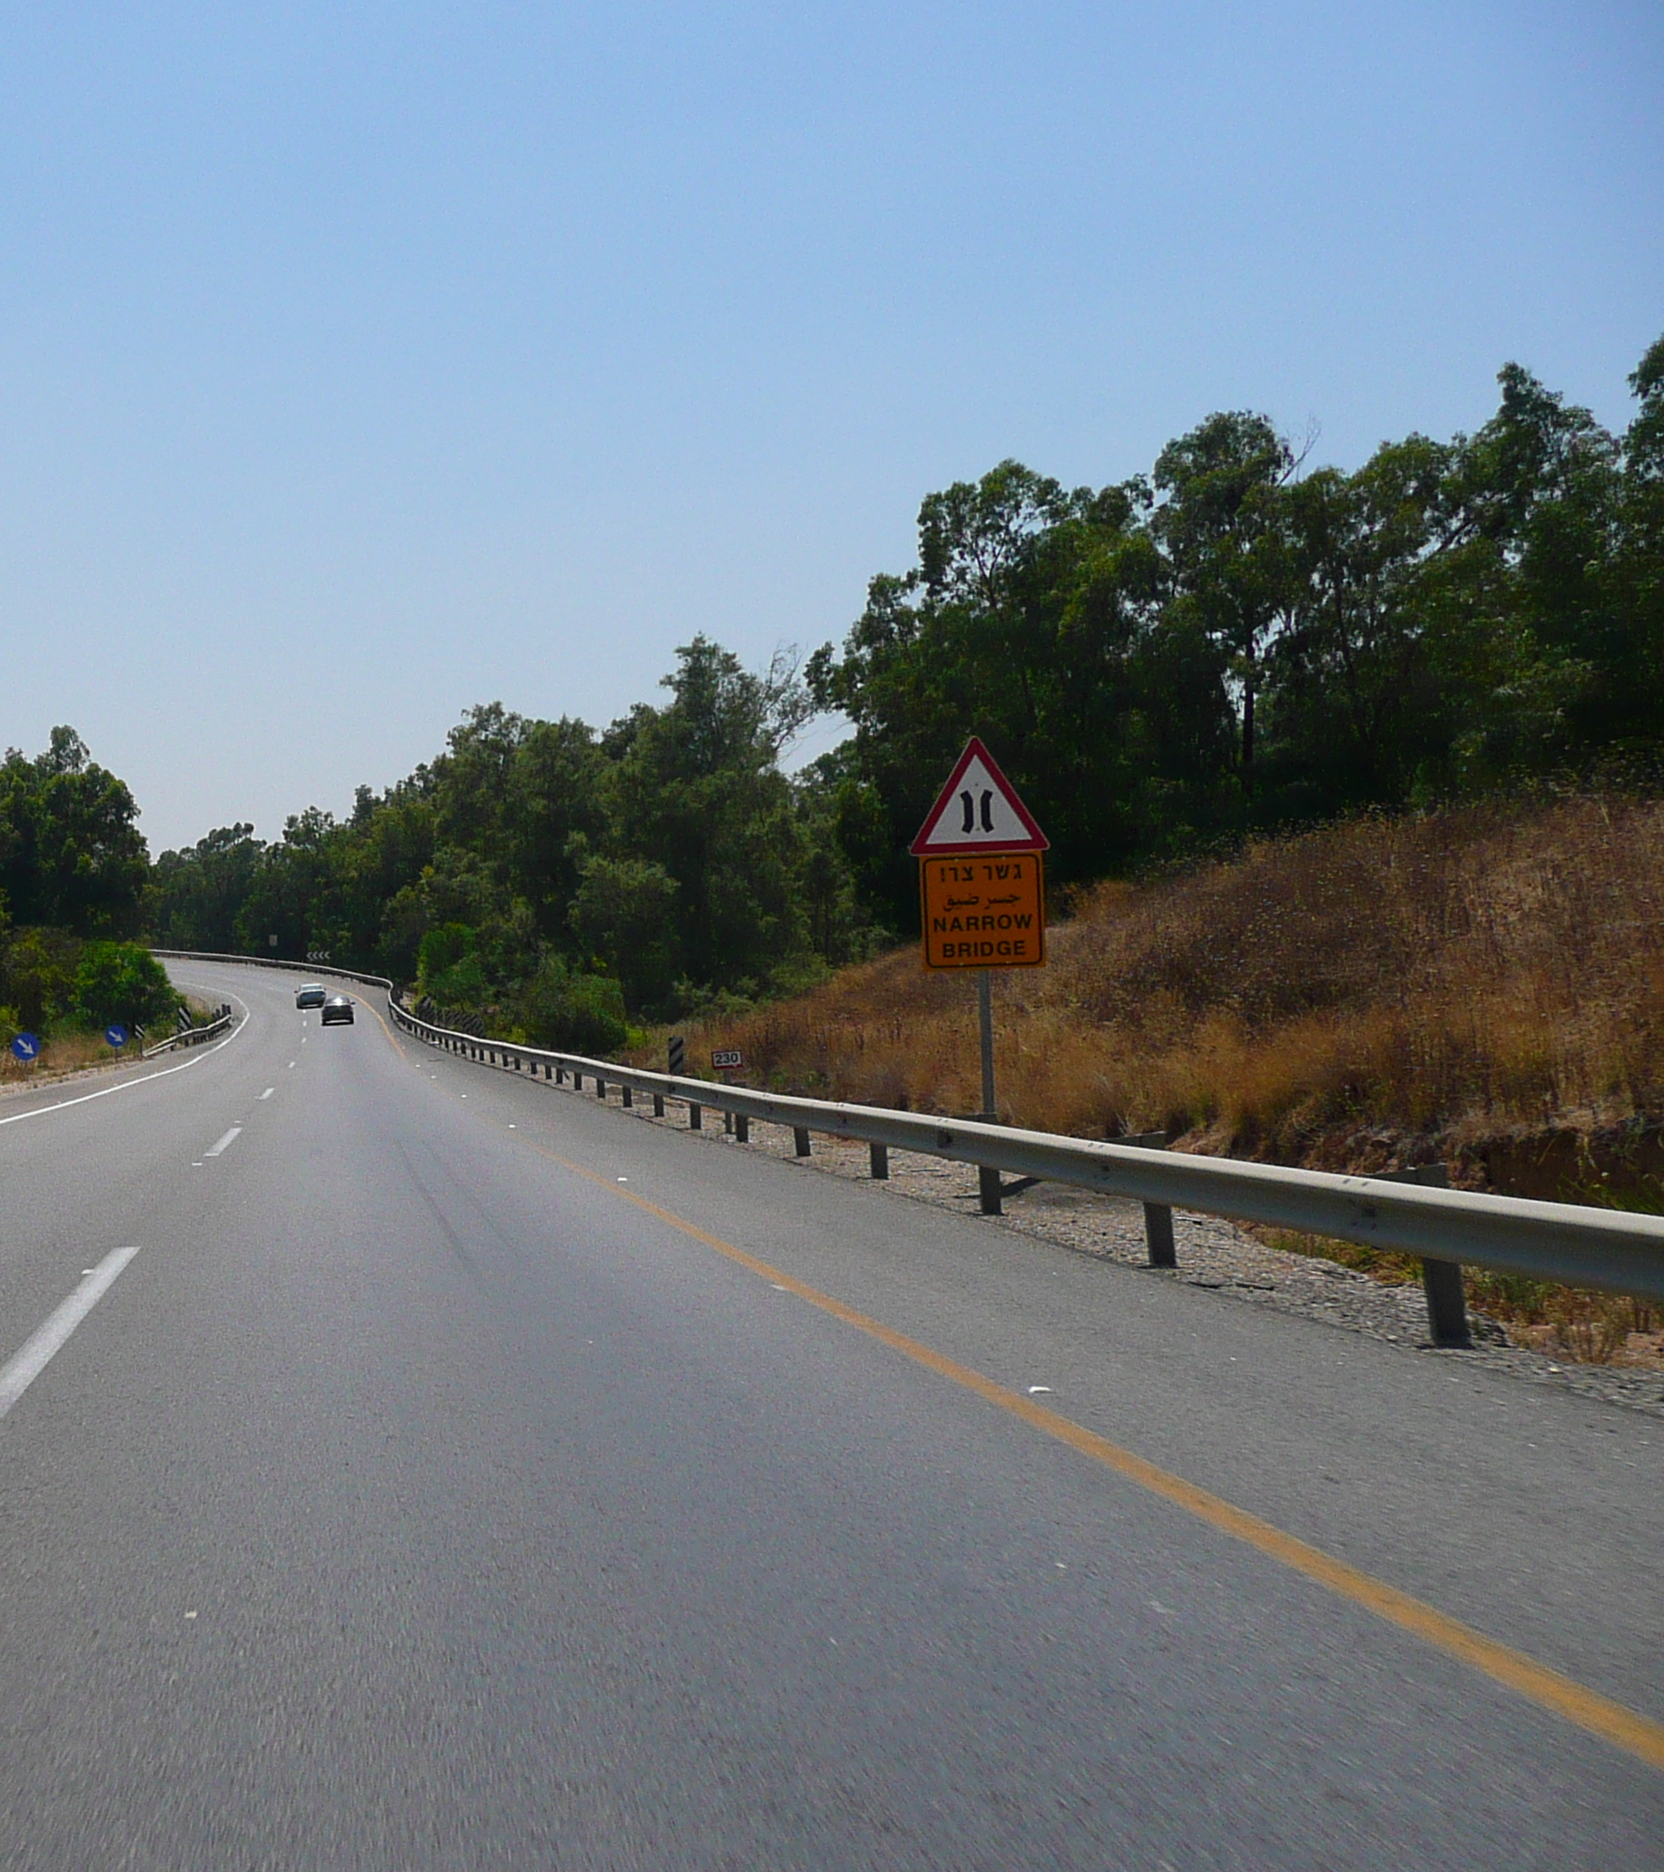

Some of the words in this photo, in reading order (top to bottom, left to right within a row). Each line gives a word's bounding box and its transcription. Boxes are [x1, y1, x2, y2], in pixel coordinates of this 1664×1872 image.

[983, 864, 1022, 879] גשר
[934, 914, 1032, 931] NARROW
[943, 940, 1025, 957] BRIDGE
[715, 1053, 738, 1064] 230
